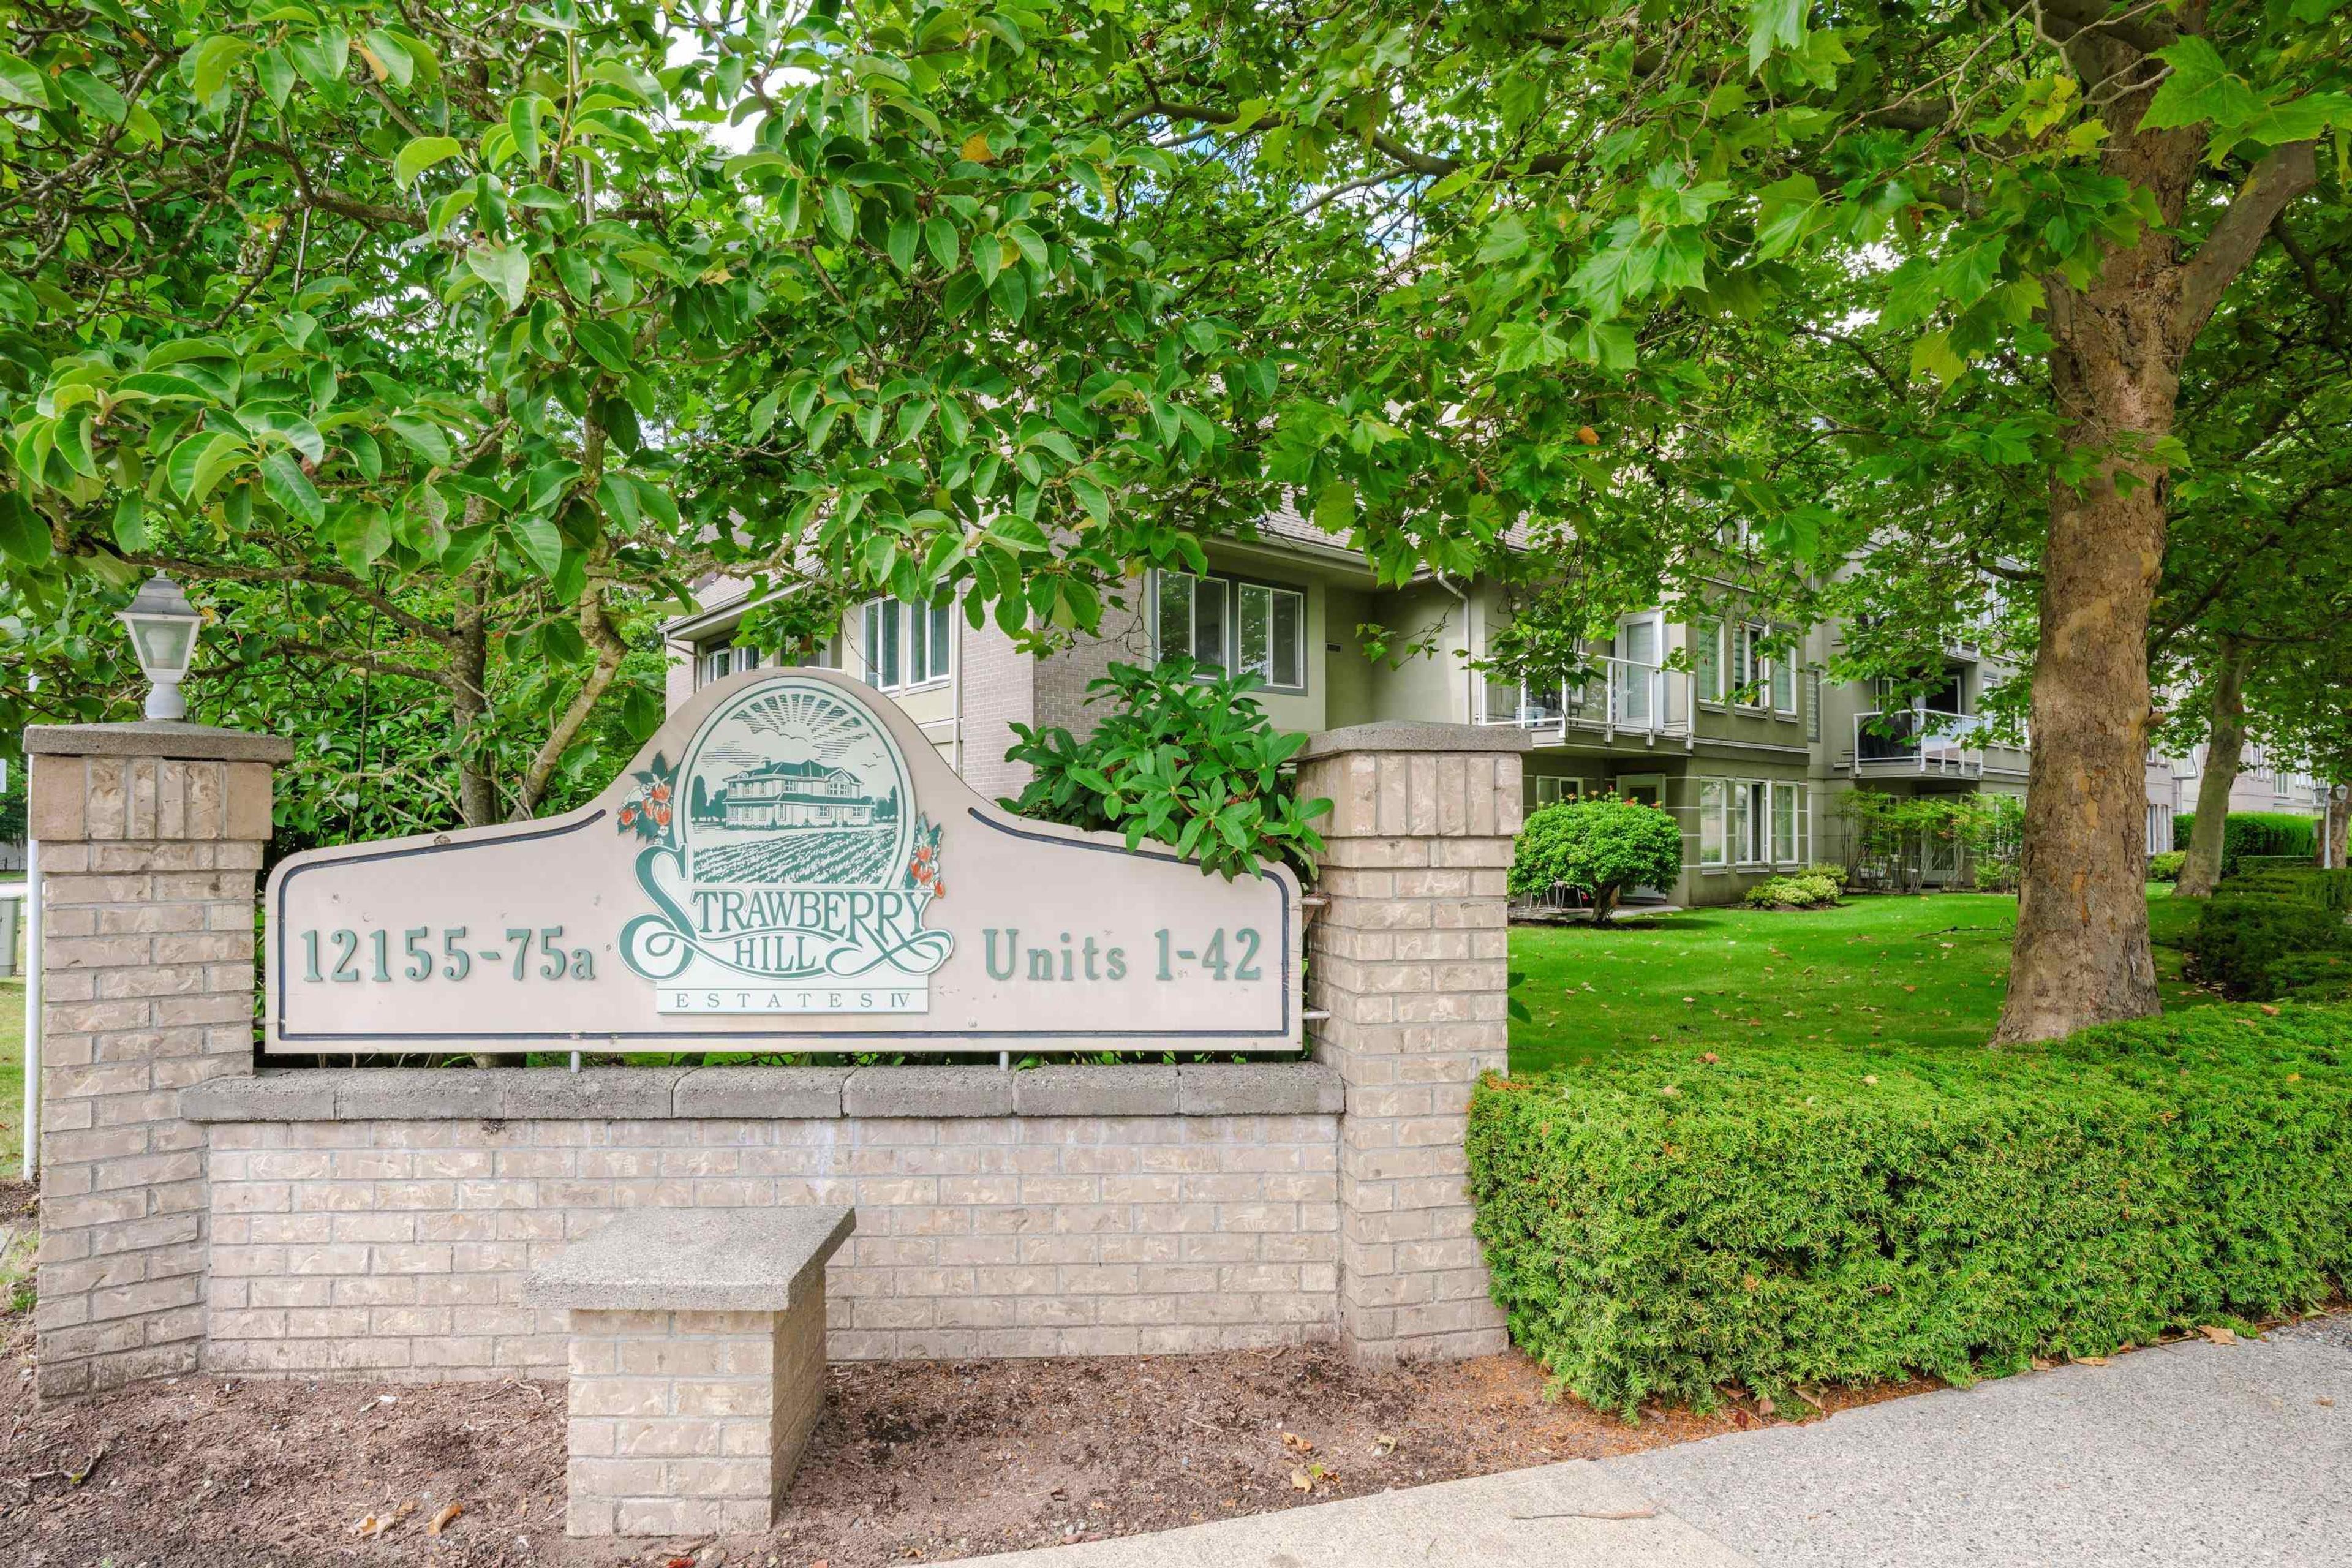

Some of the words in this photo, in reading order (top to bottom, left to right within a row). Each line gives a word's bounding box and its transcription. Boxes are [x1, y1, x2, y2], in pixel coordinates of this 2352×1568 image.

[617, 842, 952, 981] STRAWBERRY
[300, 925, 595, 982] 12155-75a
[734, 935, 817, 971] HILL
[982, 928, 1128, 981] Units
[1154, 927, 1262, 981] 1-42
[675, 992, 873, 1008] ESTATES
[890, 993, 910, 1008] IV
